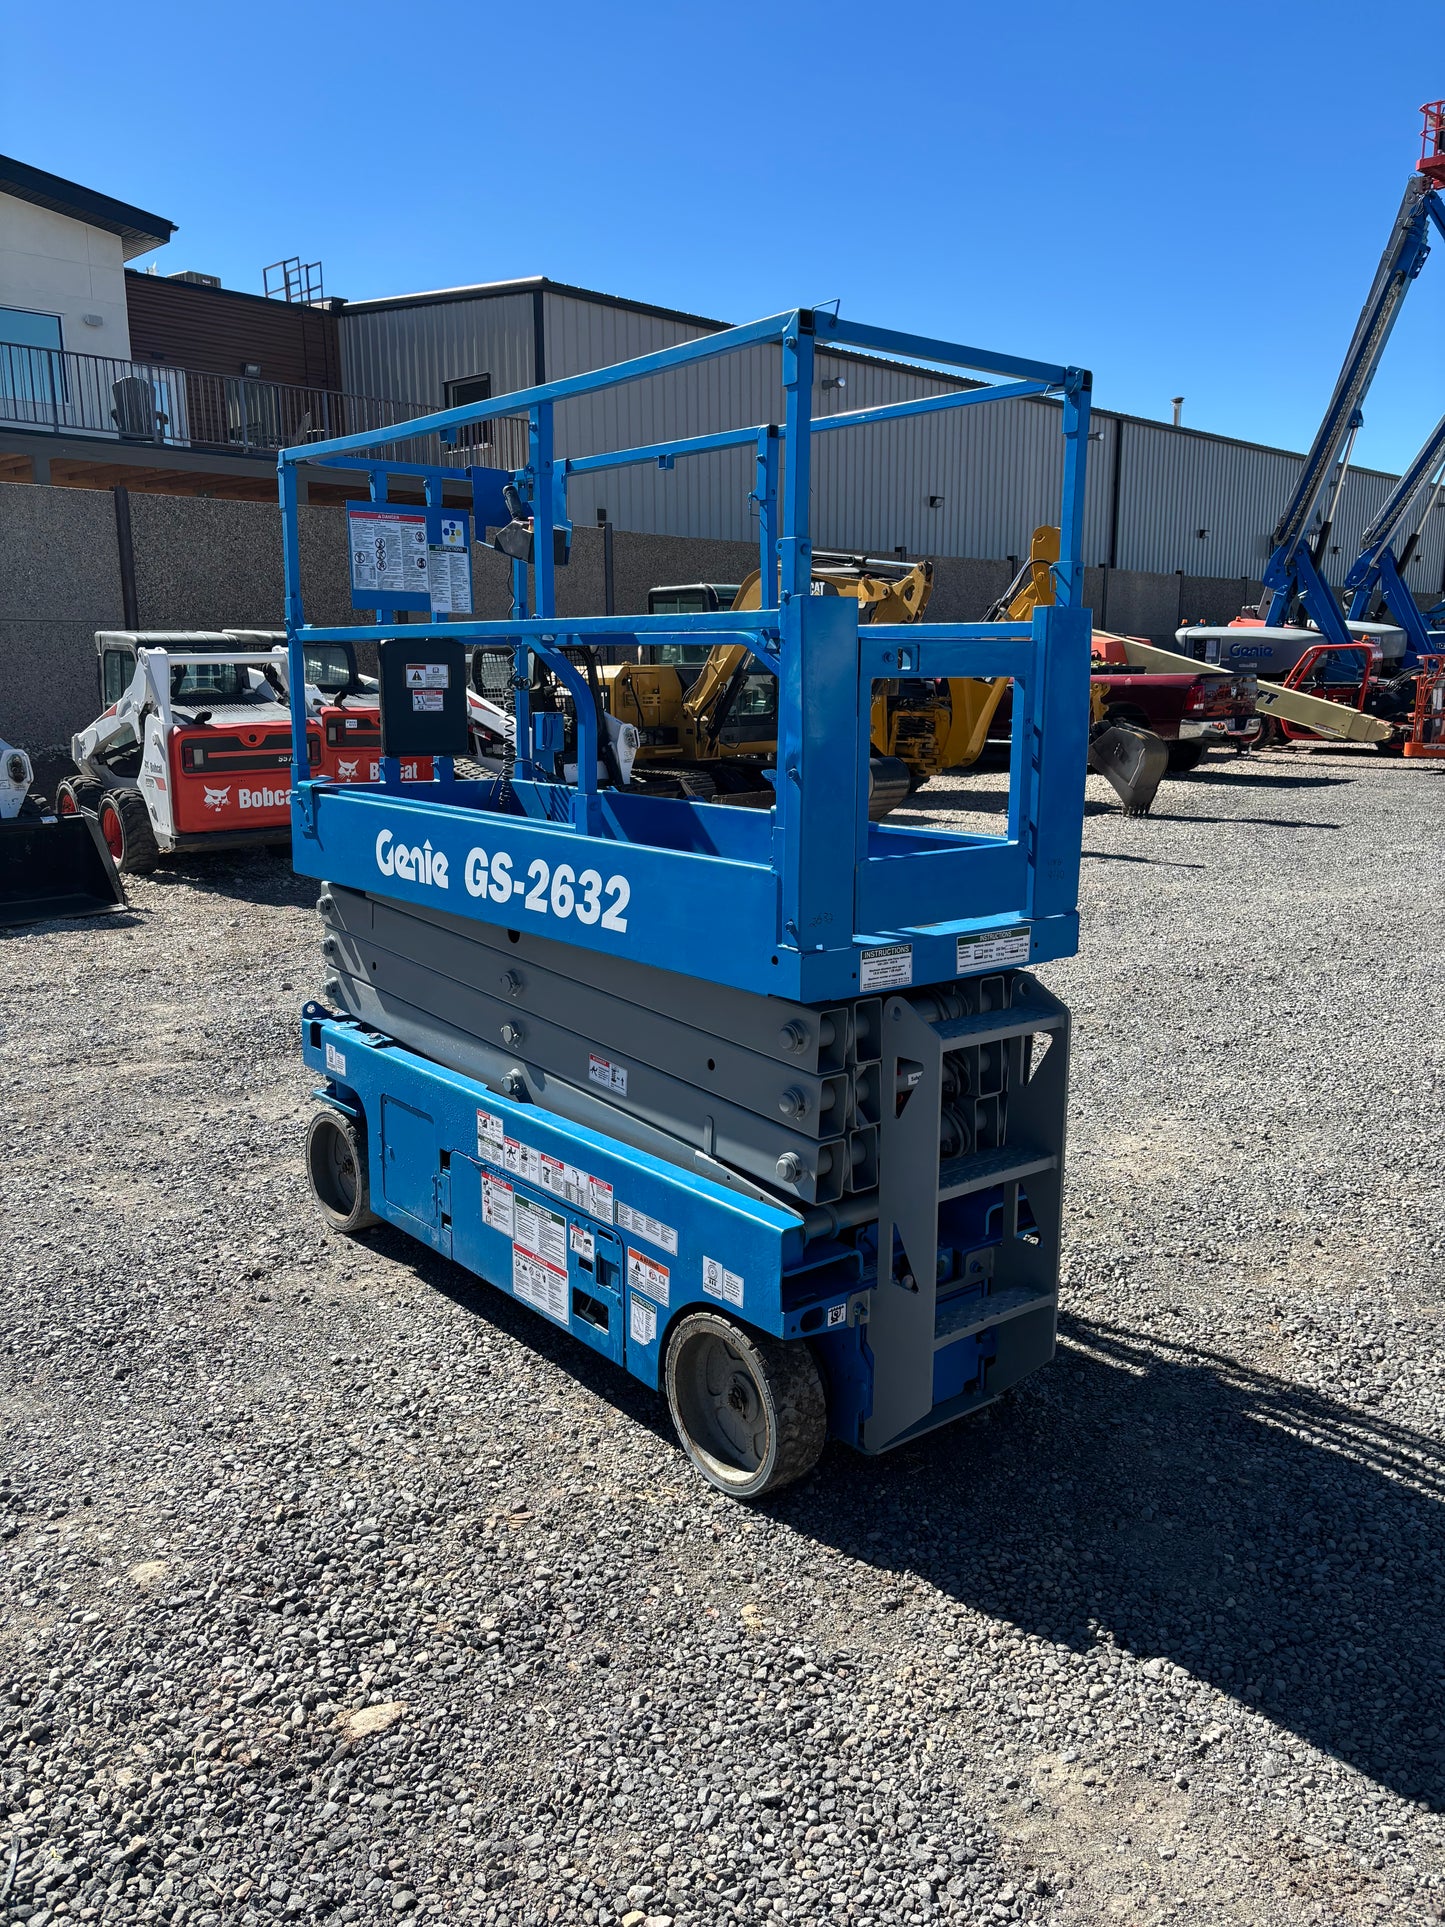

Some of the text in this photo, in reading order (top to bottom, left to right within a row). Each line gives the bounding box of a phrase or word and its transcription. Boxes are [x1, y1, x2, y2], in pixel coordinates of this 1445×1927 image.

[810, 581, 826, 596] CAT
[1229, 643, 1274, 657] Genie
[238, 787, 293, 809] Bobca
[375, 828, 631, 934] Genie GS-2632
[979, 930, 1012, 942] INSTRUCTIONS
[864, 945, 910, 959] INSTRUCTIONS
